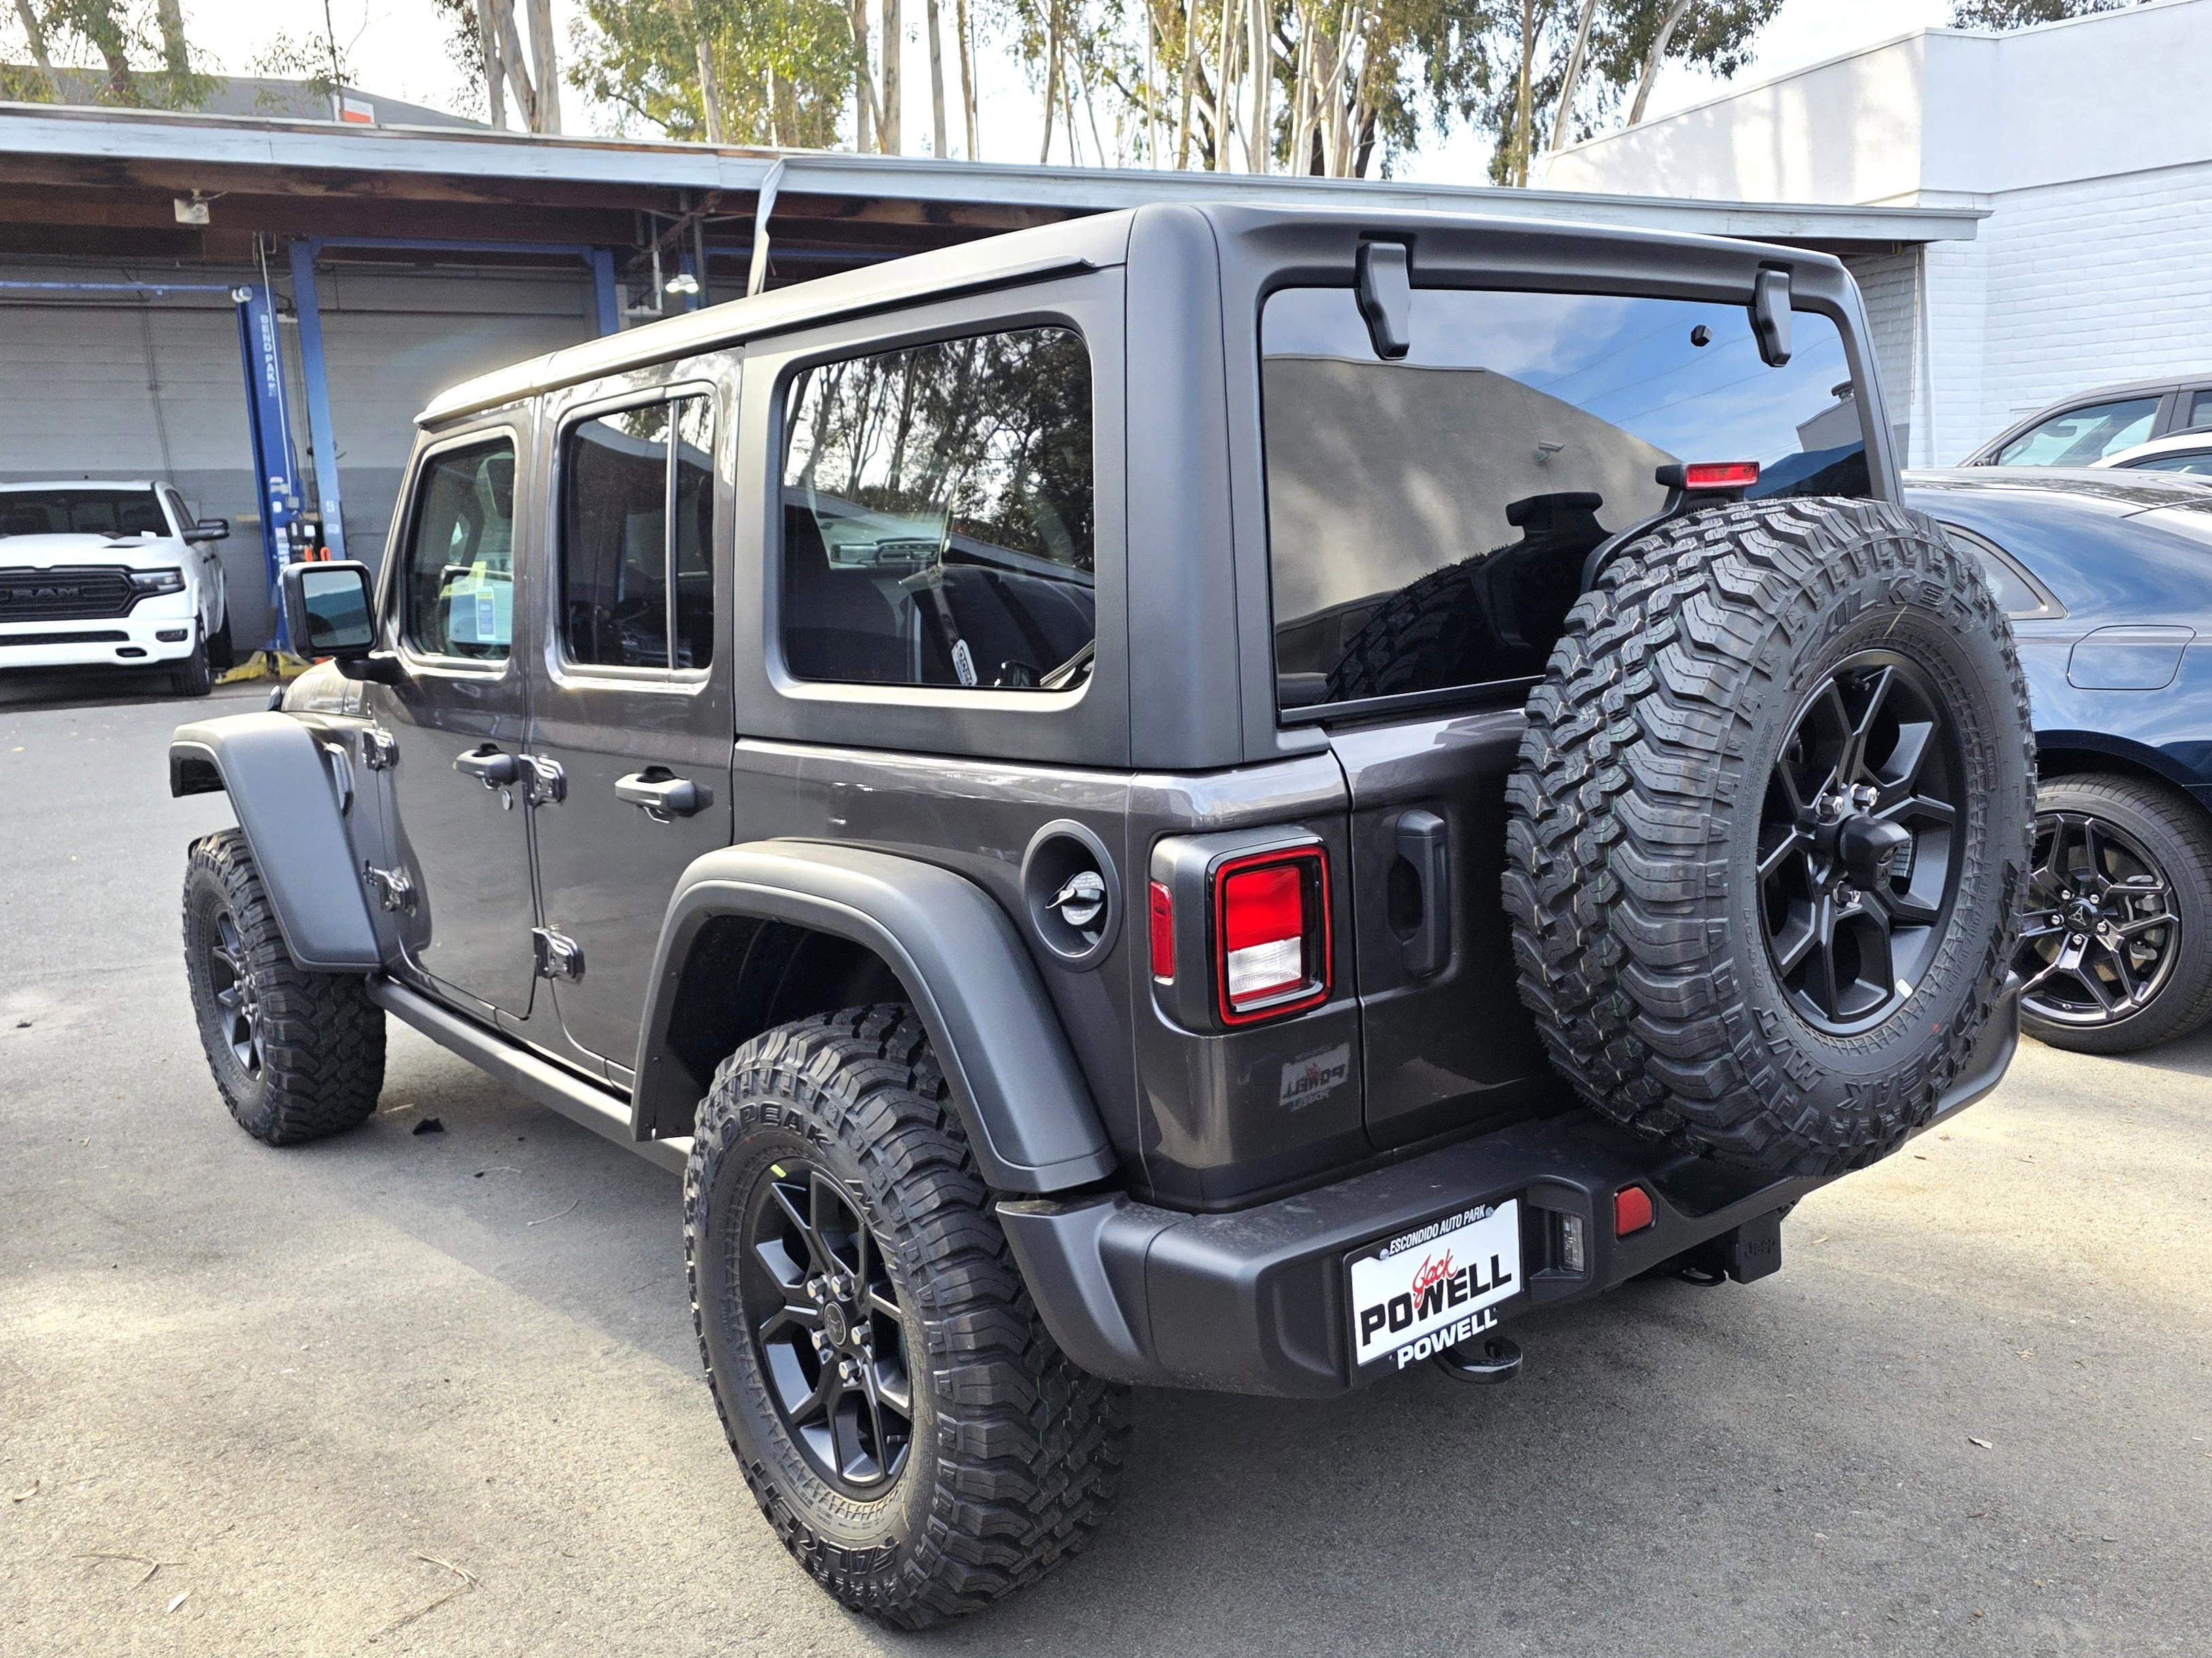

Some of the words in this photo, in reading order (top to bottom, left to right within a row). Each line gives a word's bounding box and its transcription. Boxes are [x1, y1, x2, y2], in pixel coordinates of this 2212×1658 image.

[1390, 1223, 1438, 1255] ESCONDIDO
[1439, 1214, 1463, 1235] AUTO
[1463, 1204, 1486, 1225] PARK
[1744, 1236, 1776, 1258] Jeep
[1360, 1254, 1512, 1347] POWELL
[1412, 1248, 1459, 1309] Jack
[1396, 1308, 1498, 1370] POWELL
